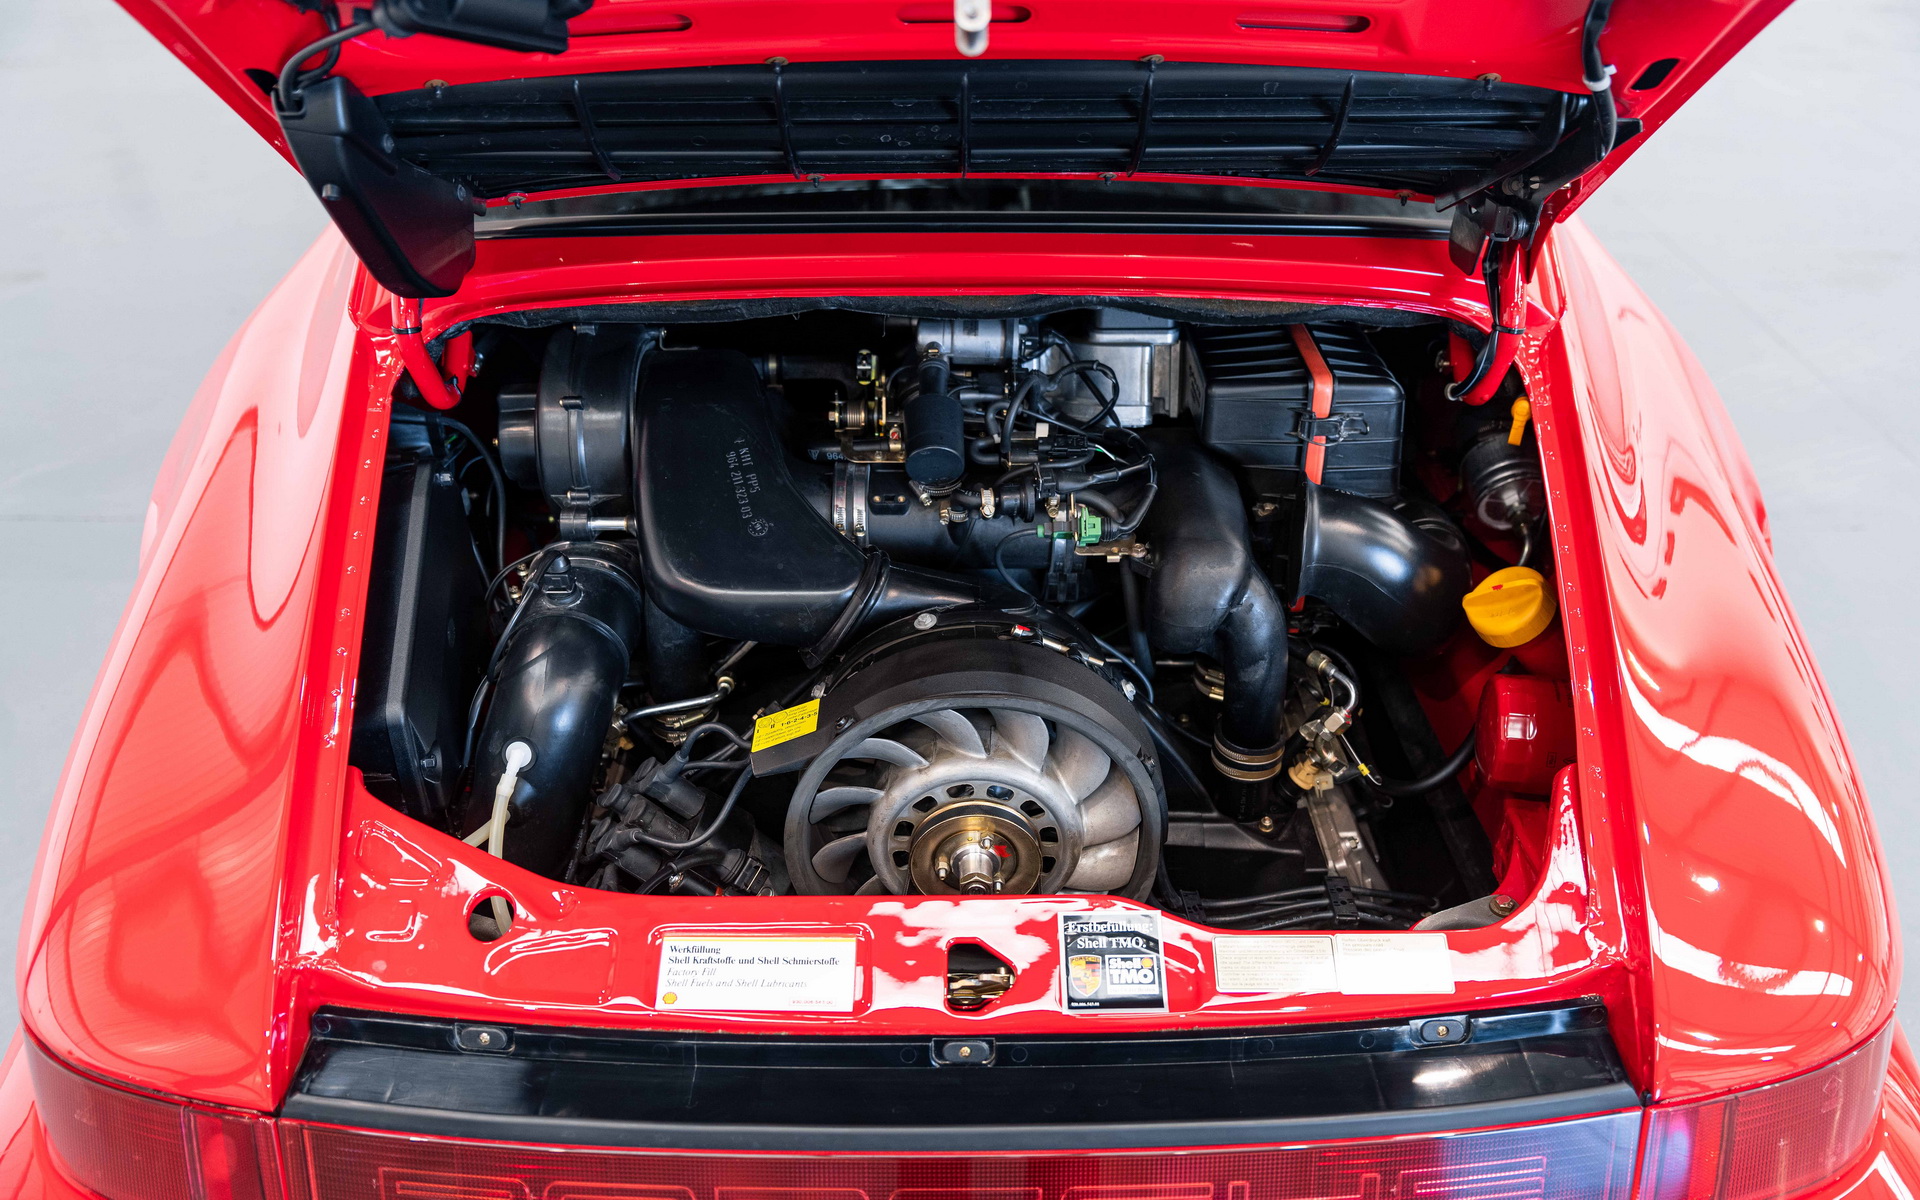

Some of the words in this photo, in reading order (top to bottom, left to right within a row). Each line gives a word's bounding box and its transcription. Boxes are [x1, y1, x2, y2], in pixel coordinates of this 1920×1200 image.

[725, 451, 739, 469] 964
[826, 452, 847, 461] 964
[730, 470, 744, 485] 211
[735, 486, 749, 504] 323
[740, 506, 753, 519] 03
[1077, 937, 1107, 949] Shell
[1110, 936, 1147, 949] TMO.
[670, 945, 721, 954] Werkfüllung
[668, 956, 690, 964] Shell
[693, 956, 736, 964] Kraftstoffe
[757, 957, 780, 965] Shell
[782, 957, 840, 965] Schmierstoffe
[1109, 957, 1141, 969] Shell
[667, 968, 698, 976] Factory
[702, 968, 717, 976] Fill
[1109, 969, 1154, 984] TMO
[666, 979, 688, 987] Shell
[691, 979, 713, 987] Fuels
[716, 979, 734, 987] and
[735, 979, 758, 987] Shell
[761, 979, 807, 988] Lubricants
